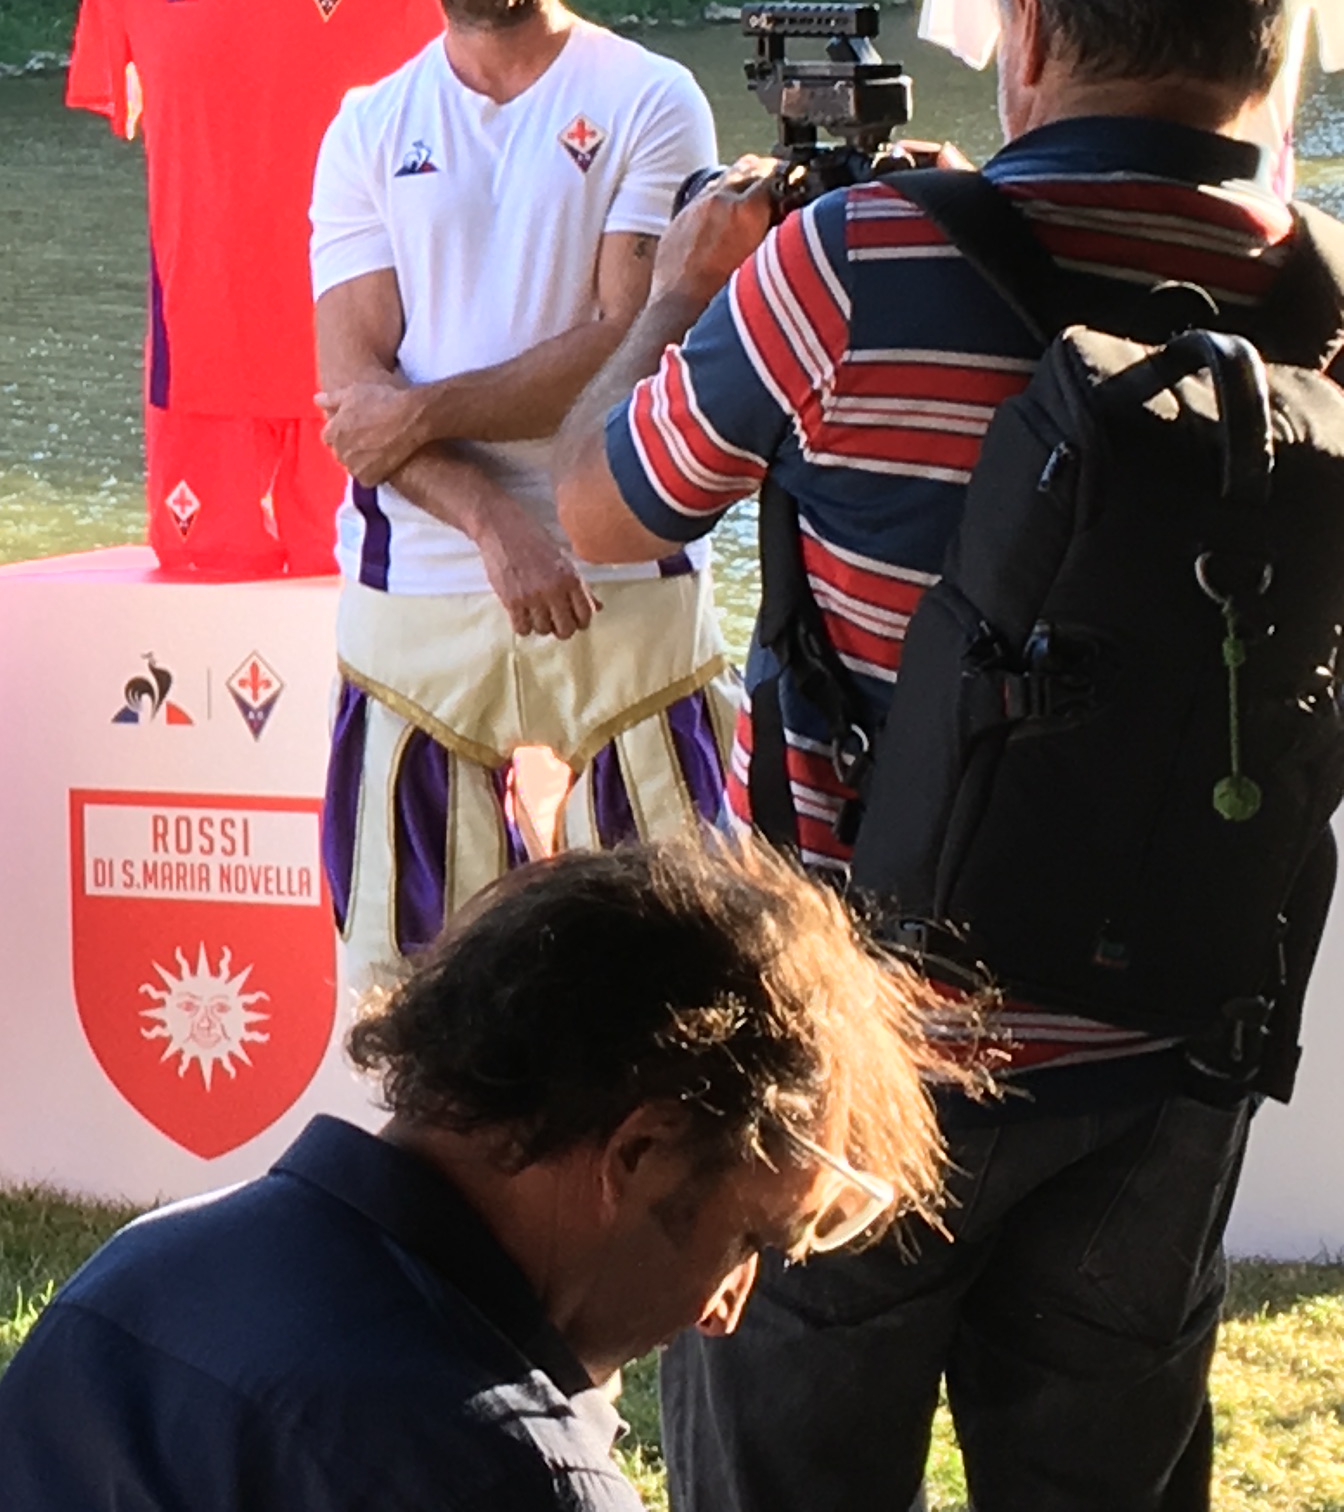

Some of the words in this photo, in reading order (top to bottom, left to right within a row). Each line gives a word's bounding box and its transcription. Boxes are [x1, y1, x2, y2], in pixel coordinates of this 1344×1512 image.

[151, 814, 250, 857] ROSSI
[93, 857, 114, 888] DI
[219, 863, 312, 897] NOVELLA
